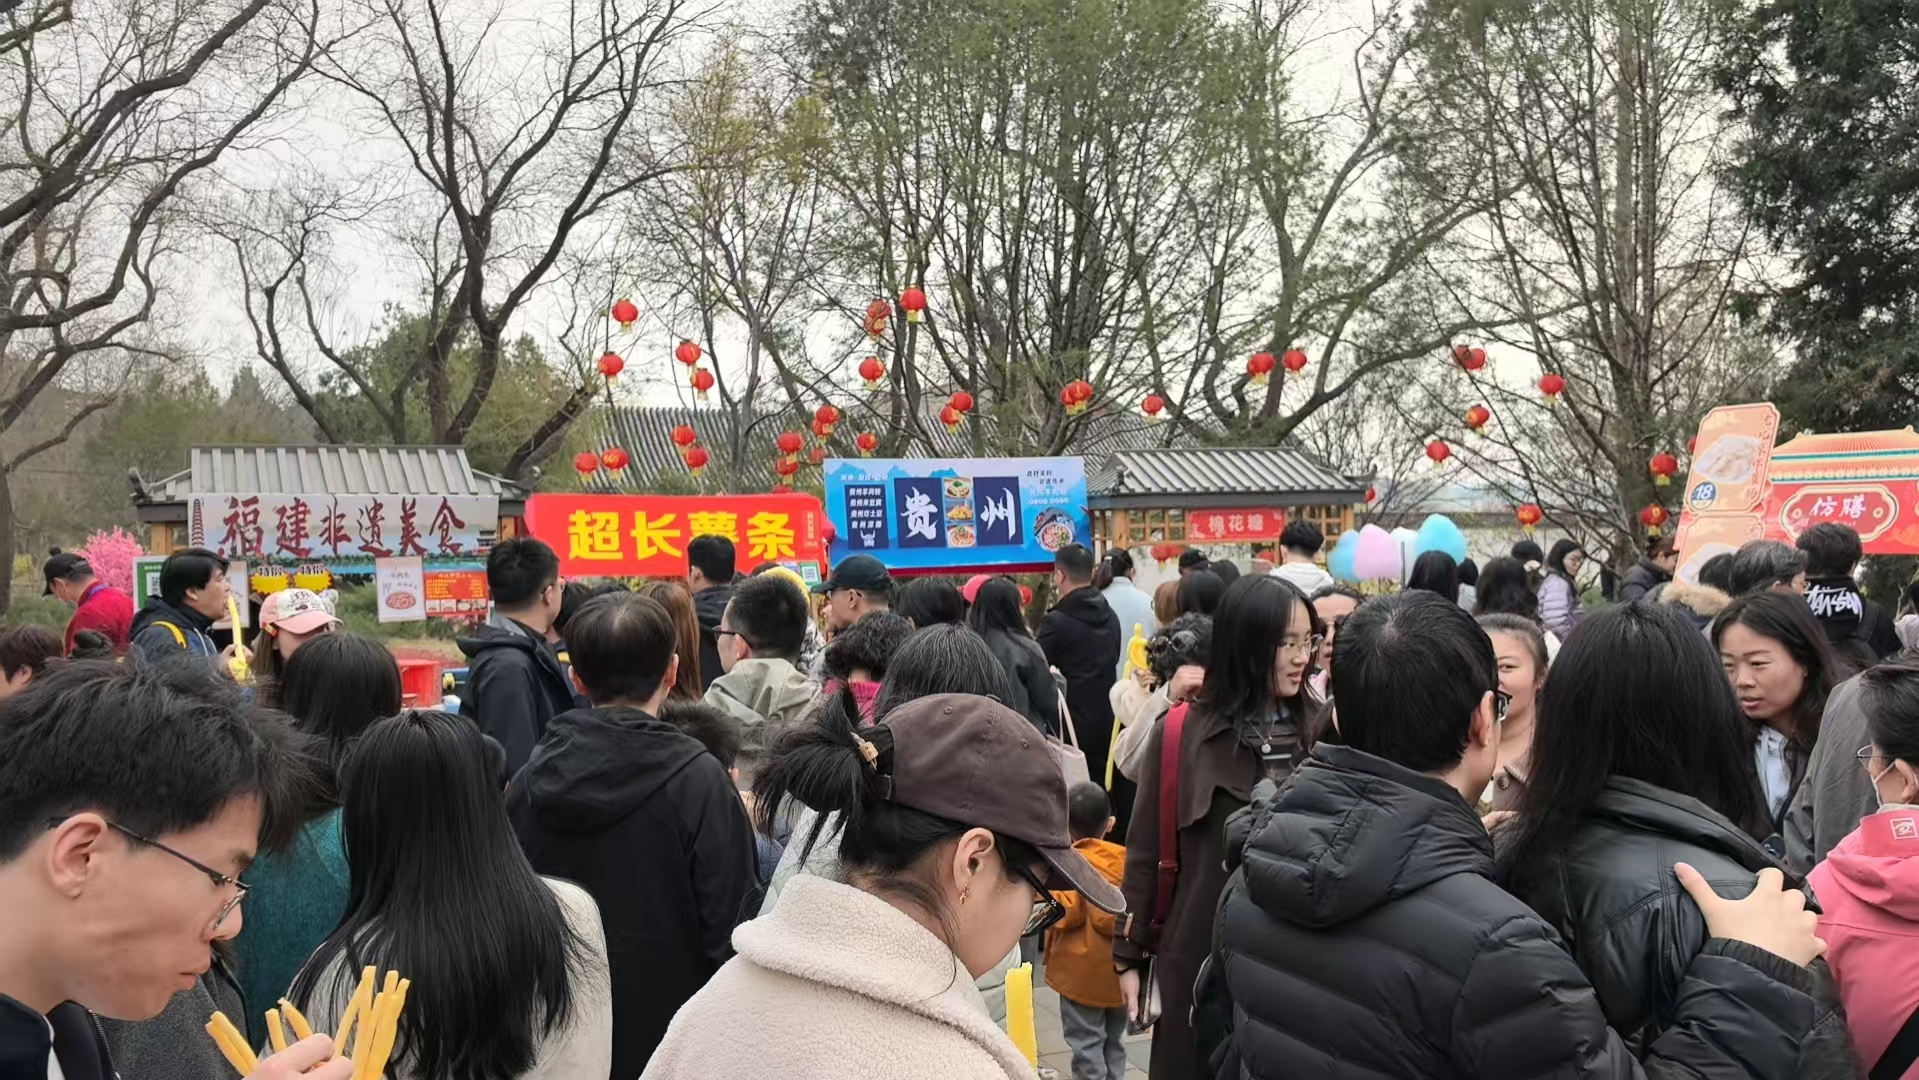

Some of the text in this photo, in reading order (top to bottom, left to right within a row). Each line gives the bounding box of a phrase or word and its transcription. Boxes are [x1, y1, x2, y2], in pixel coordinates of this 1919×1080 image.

[1696, 484, 1714, 500] 18
[1810, 494, 1866, 518] 仿膳
[219, 495, 466, 559] 福建非遗美食
[900, 486, 1016, 540] 贵州
[1208, 513, 1264, 532] 棉花糖
[568, 510, 796, 560] 超长薯条
